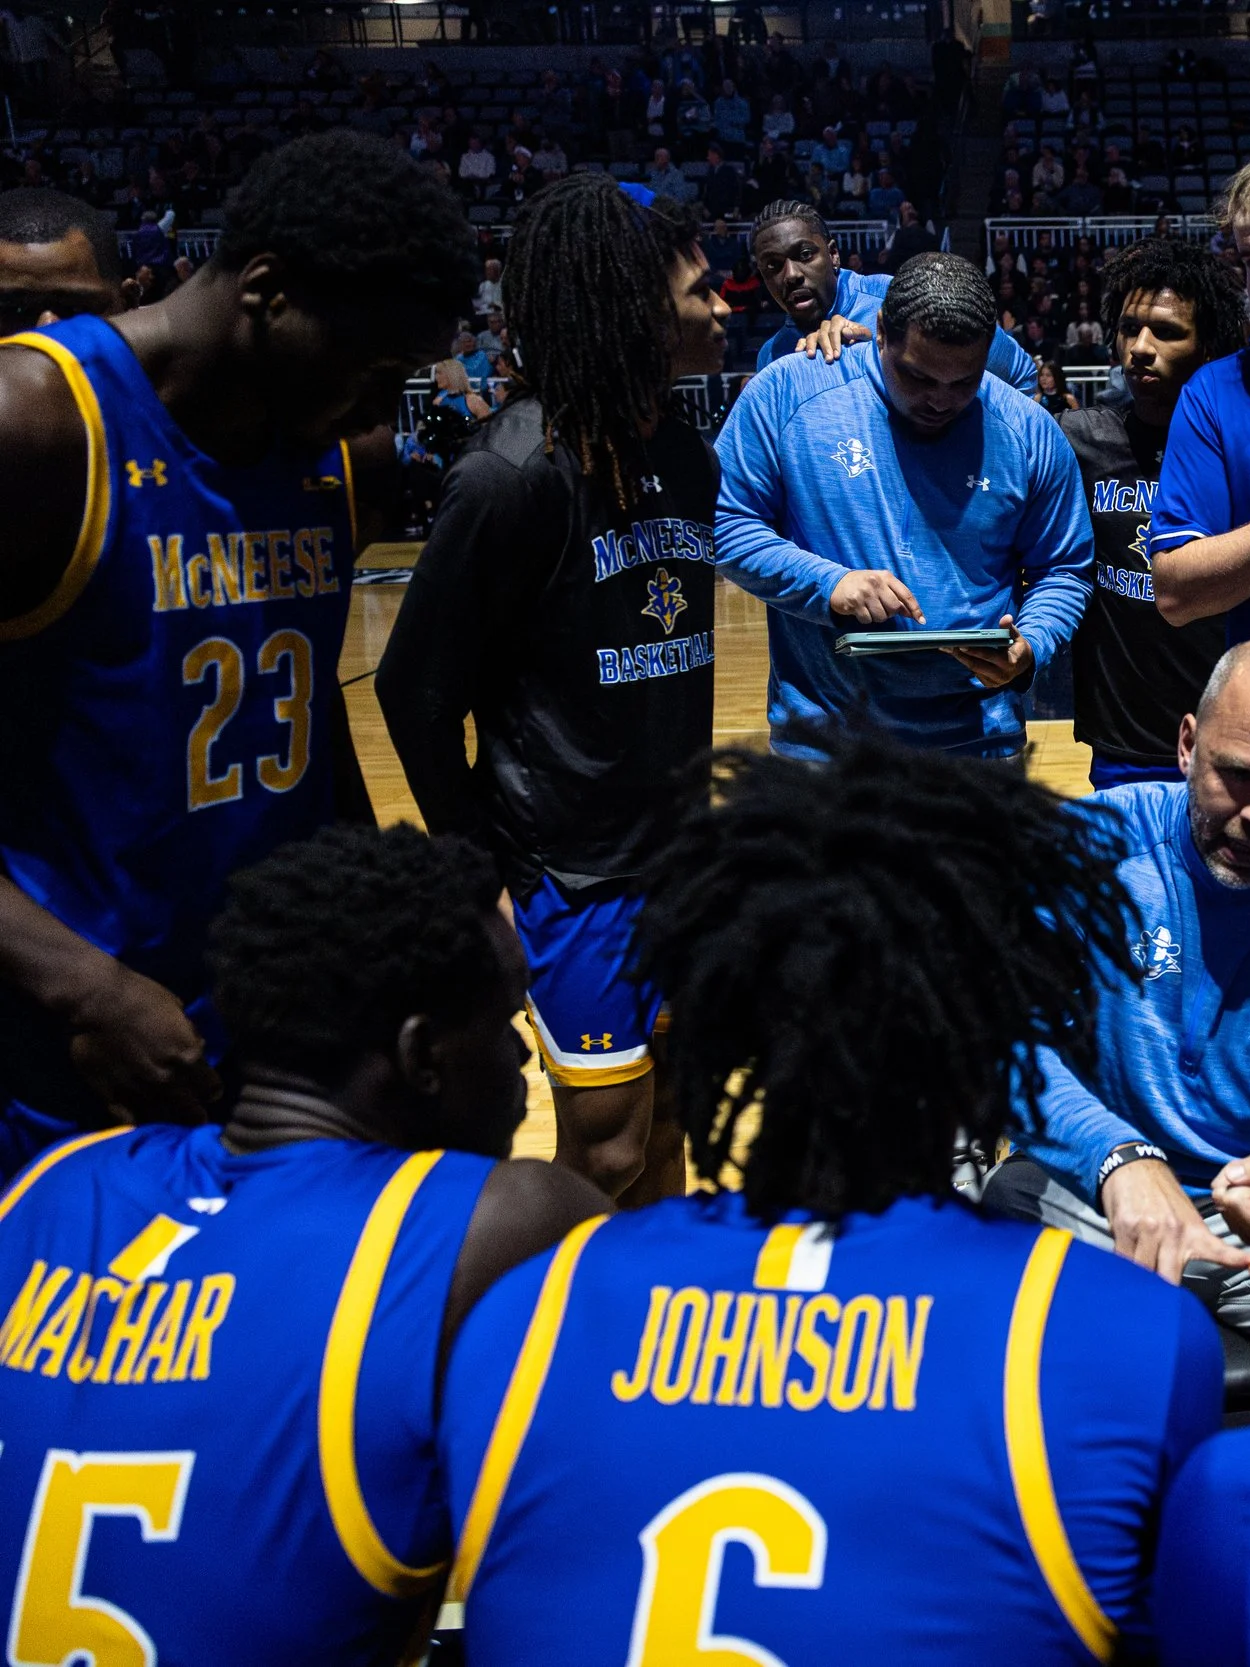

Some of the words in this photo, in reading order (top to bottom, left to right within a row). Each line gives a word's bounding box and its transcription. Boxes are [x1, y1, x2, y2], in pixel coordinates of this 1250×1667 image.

[147, 527, 340, 612] McNEESE
[592, 518, 716, 582] McNEESE
[1096, 560, 1156, 602] BASKE
[182, 628, 313, 813] 23
[0, 1259, 236, 1385] MACHAR
[611, 1286, 934, 1412] JOHNSON
[0, 1441, 196, 1667] 5
